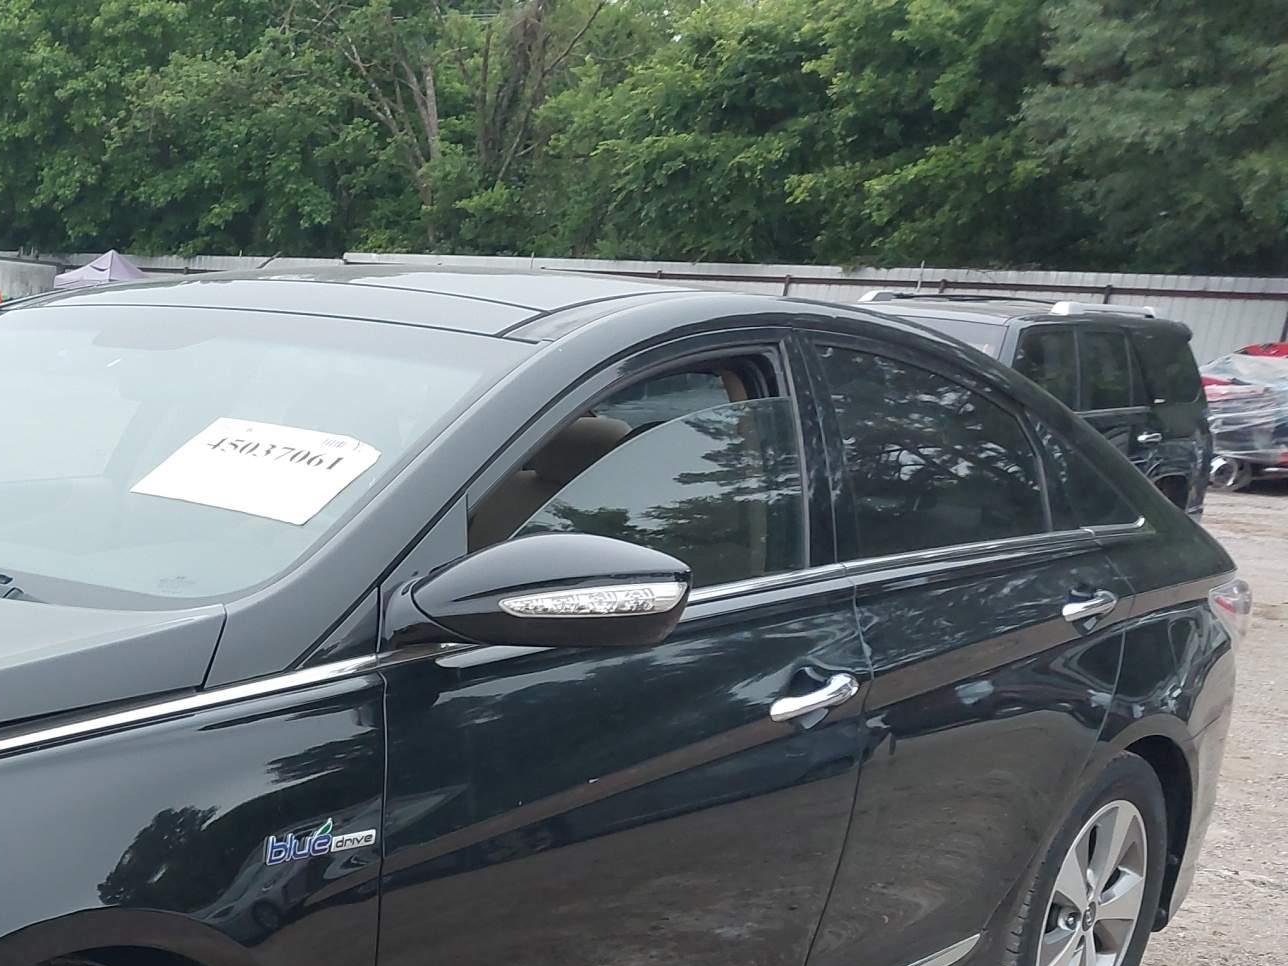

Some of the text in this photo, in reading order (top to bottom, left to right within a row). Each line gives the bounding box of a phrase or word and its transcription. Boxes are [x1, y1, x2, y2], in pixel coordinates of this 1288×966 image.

[207, 436, 344, 471] 45037061
[265, 831, 374, 866] blue drive
